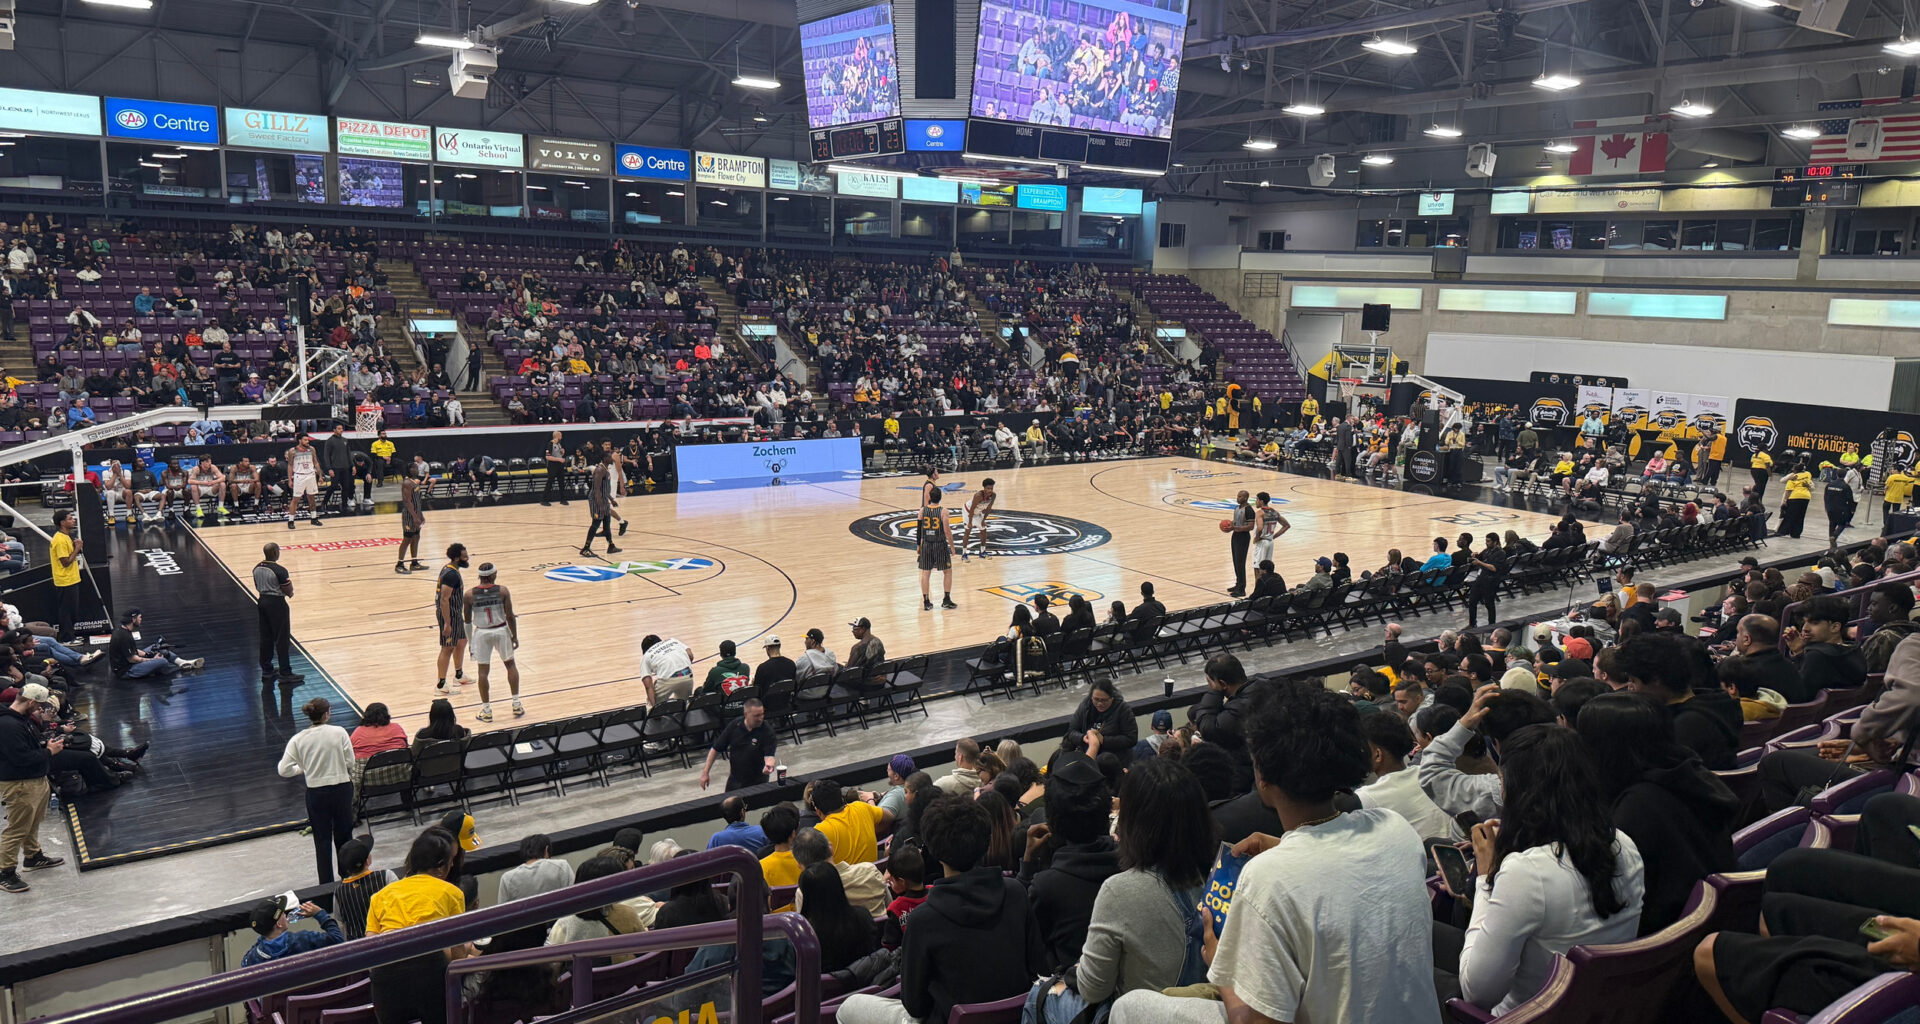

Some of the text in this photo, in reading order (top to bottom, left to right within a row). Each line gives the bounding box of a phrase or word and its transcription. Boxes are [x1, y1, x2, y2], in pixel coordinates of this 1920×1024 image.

[120, 112, 210, 132] CAA Centre
[244, 112, 309, 133] GILLZ
[883, 121, 897, 131] GUEST
[248, 132, 309, 144] Sweet Factory
[384, 125, 428, 138] DEPOT
[814, 131, 826, 140] HOME
[1016, 127, 1033, 137] HOME
[869, 135, 874, 151] 2
[887, 132, 898, 149] 23
[926, 140, 943, 148] Centre
[1115, 138, 1132, 147] GUEST
[462, 142, 521, 153] Ontario Virtual
[817, 142, 828, 158] 28
[478, 150, 508, 159] School
[539, 149, 601, 162] VOLVO
[647, 156, 685, 171] Centre
[717, 158, 763, 175] BRAMPTON
[1808, 166, 1831, 176] 10:00
[98, 421, 139, 436] PERFORMANCE
[1804, 431, 1844, 441] BRAMPTON
[752, 444, 796, 457] Zochem
[1787, 435, 1860, 454] HONEY BADGERS
[1414, 456, 1435, 464] CANADA'S
[1412, 464, 1435, 472] BASKETBALL
[923, 516, 940, 530] 33
[484, 607, 493, 624] 1
